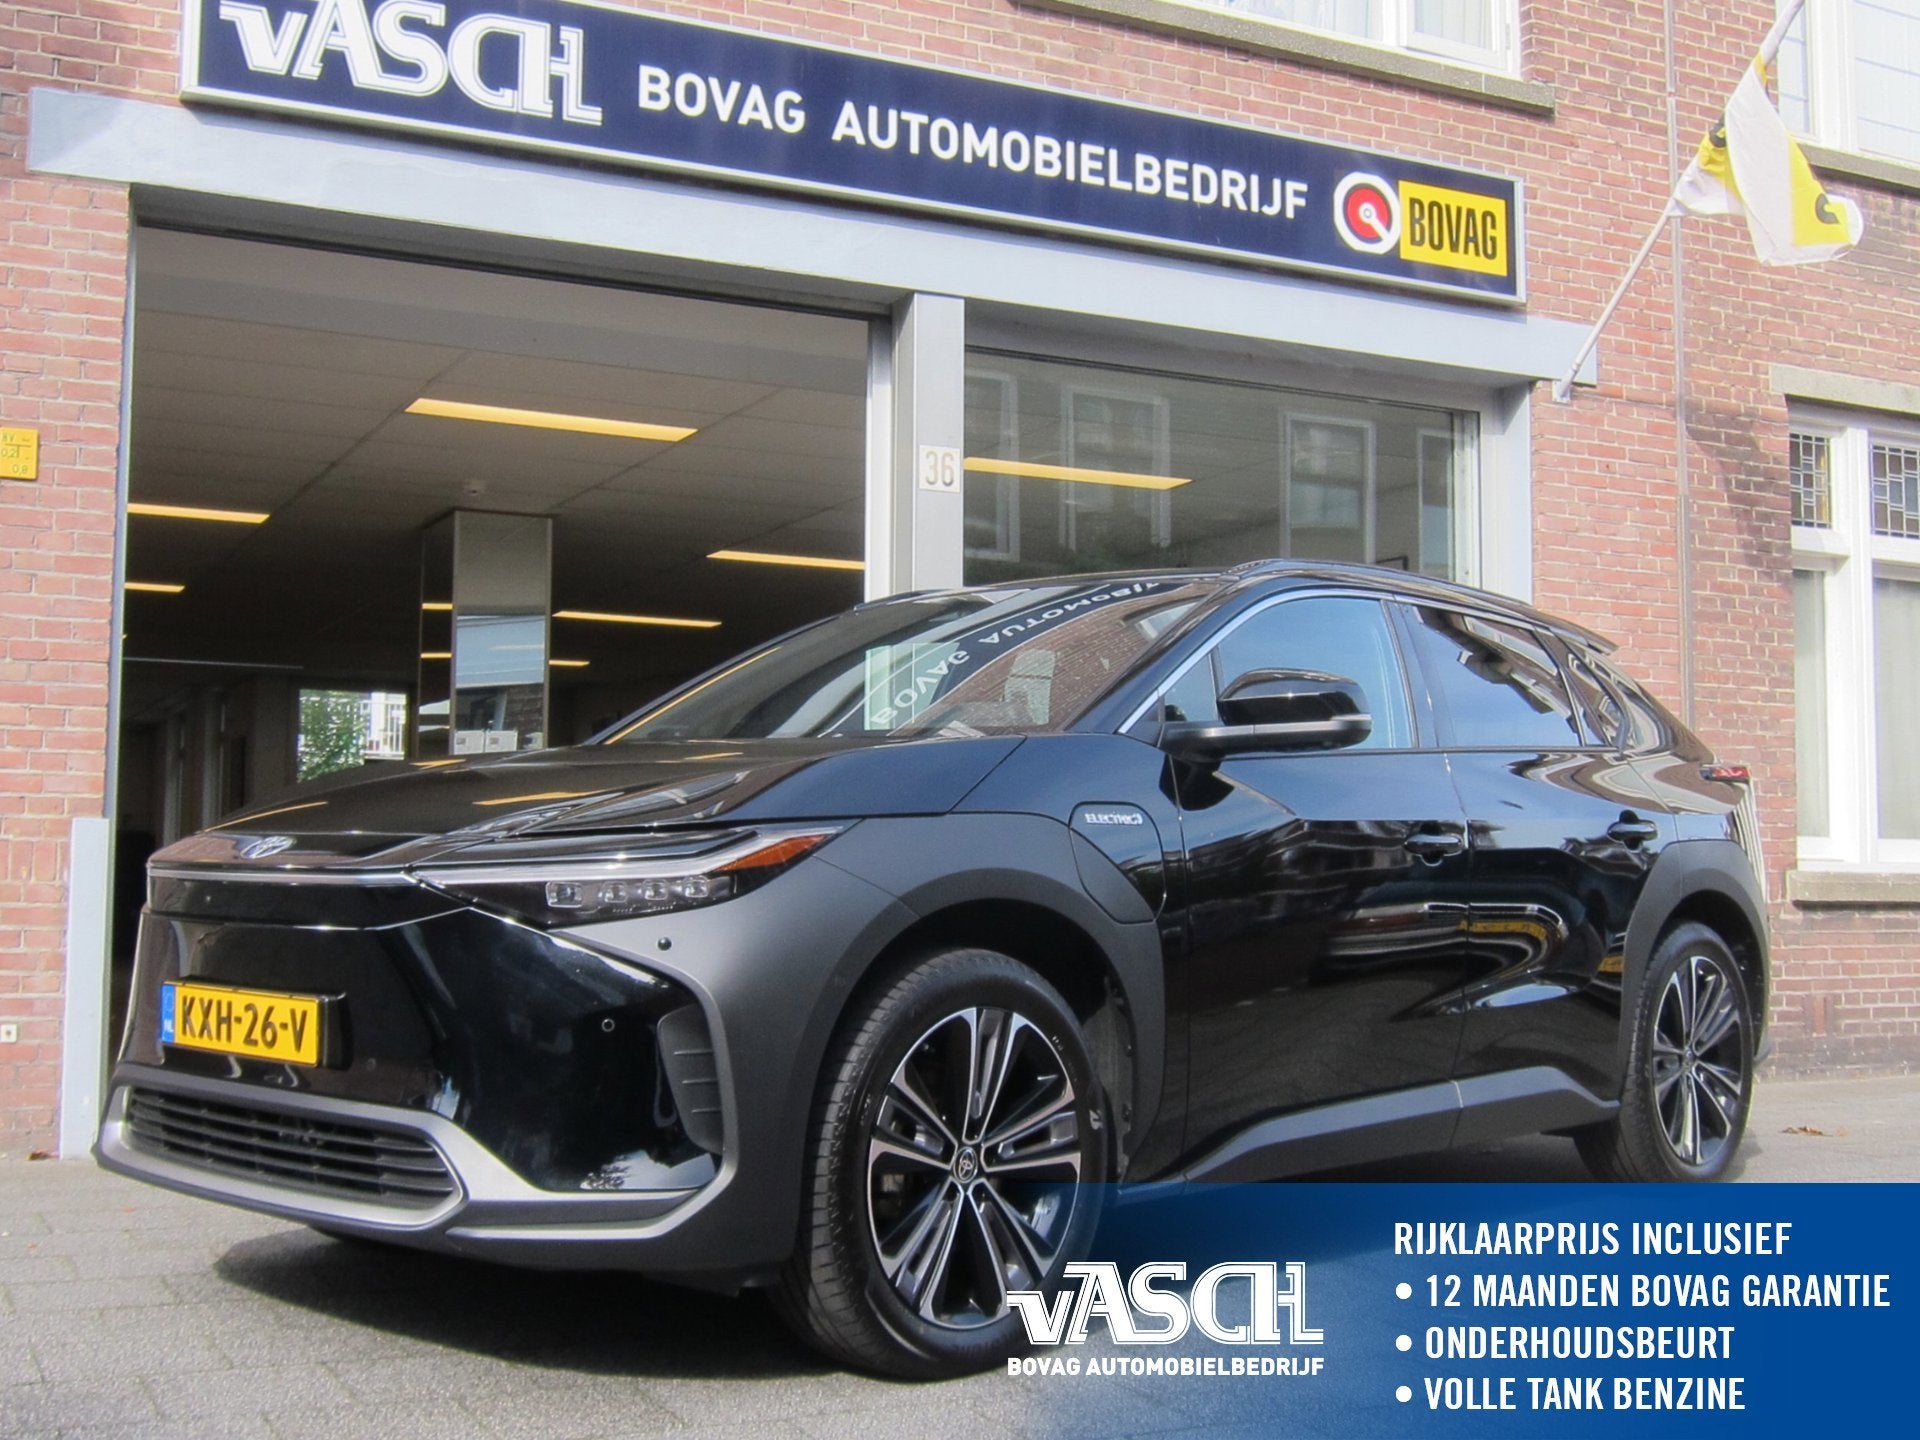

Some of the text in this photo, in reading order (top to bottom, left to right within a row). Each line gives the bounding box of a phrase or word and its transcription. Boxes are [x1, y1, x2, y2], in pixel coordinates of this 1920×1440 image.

[638, 64, 805, 133] BOVAG
[831, 101, 1308, 219] AUTOMOBIELBEDRIJF
[1409, 197, 1497, 260] BOVAG
[926, 451, 954, 486] 36
[182, 996, 307, 1053] KXH-26-V
